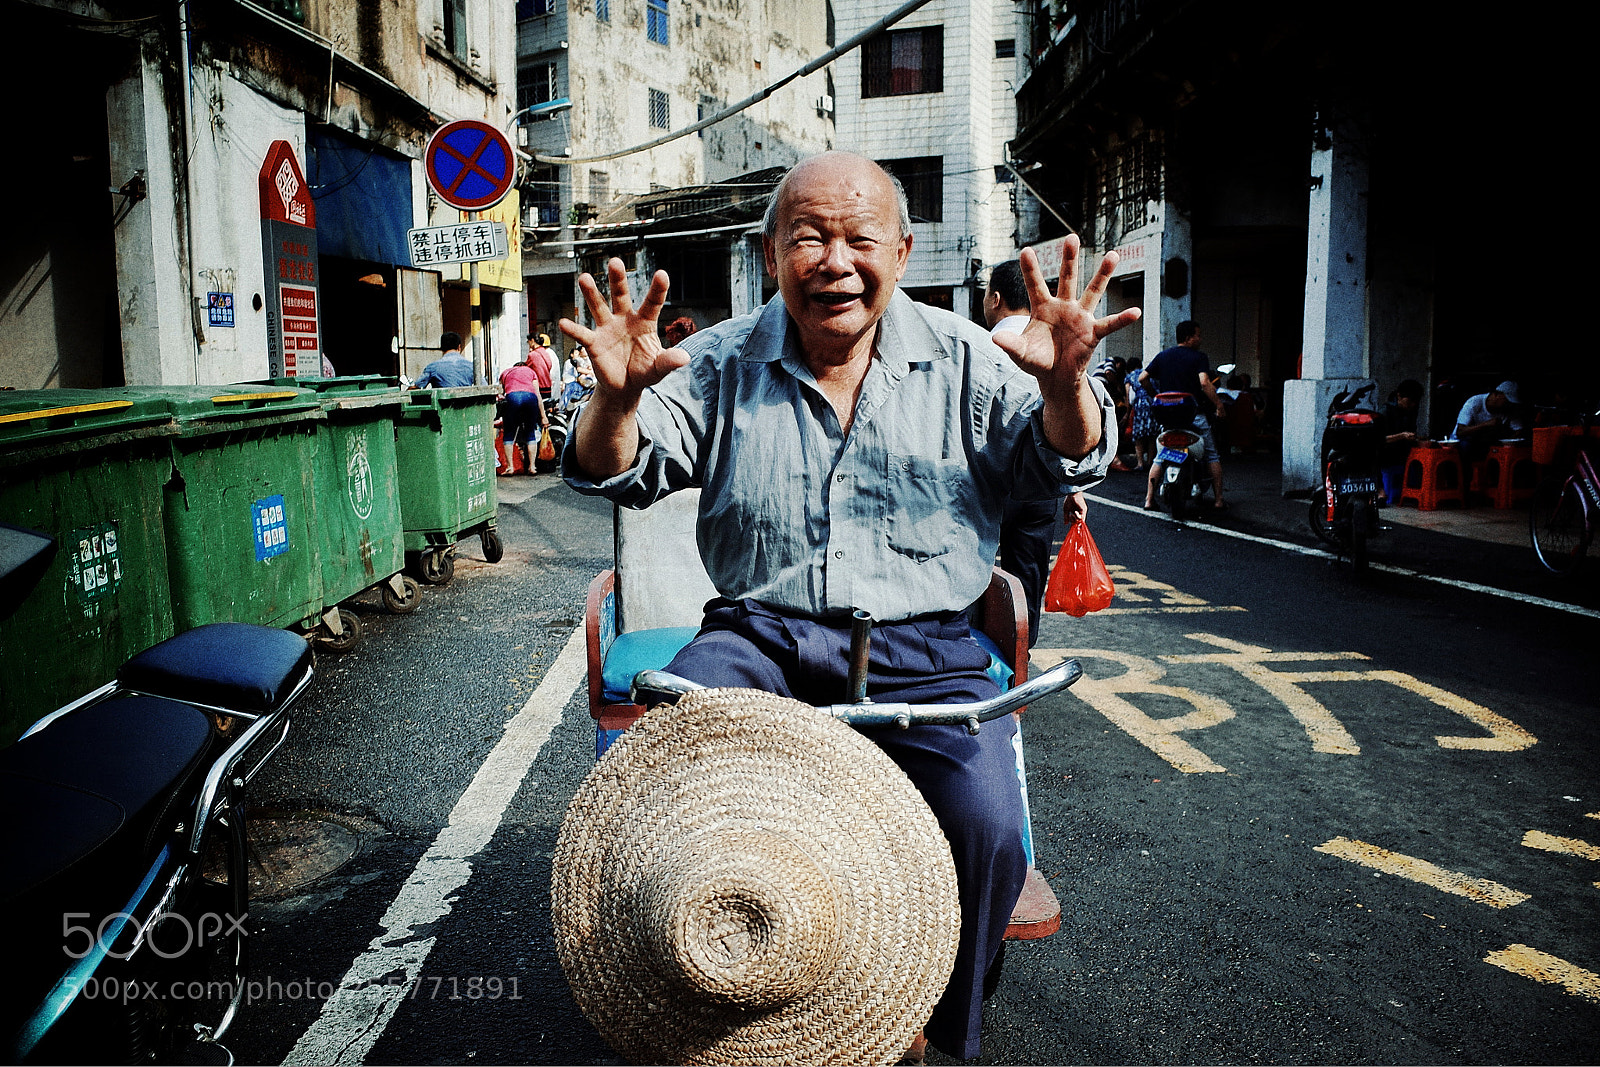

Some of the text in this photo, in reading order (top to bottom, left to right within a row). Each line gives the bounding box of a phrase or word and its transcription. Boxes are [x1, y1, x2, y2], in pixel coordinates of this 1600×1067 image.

[412, 225, 490, 248] 禁止停车
[414, 240, 493, 263] 违停抓拍
[267, 311, 277, 358] CHINESE
